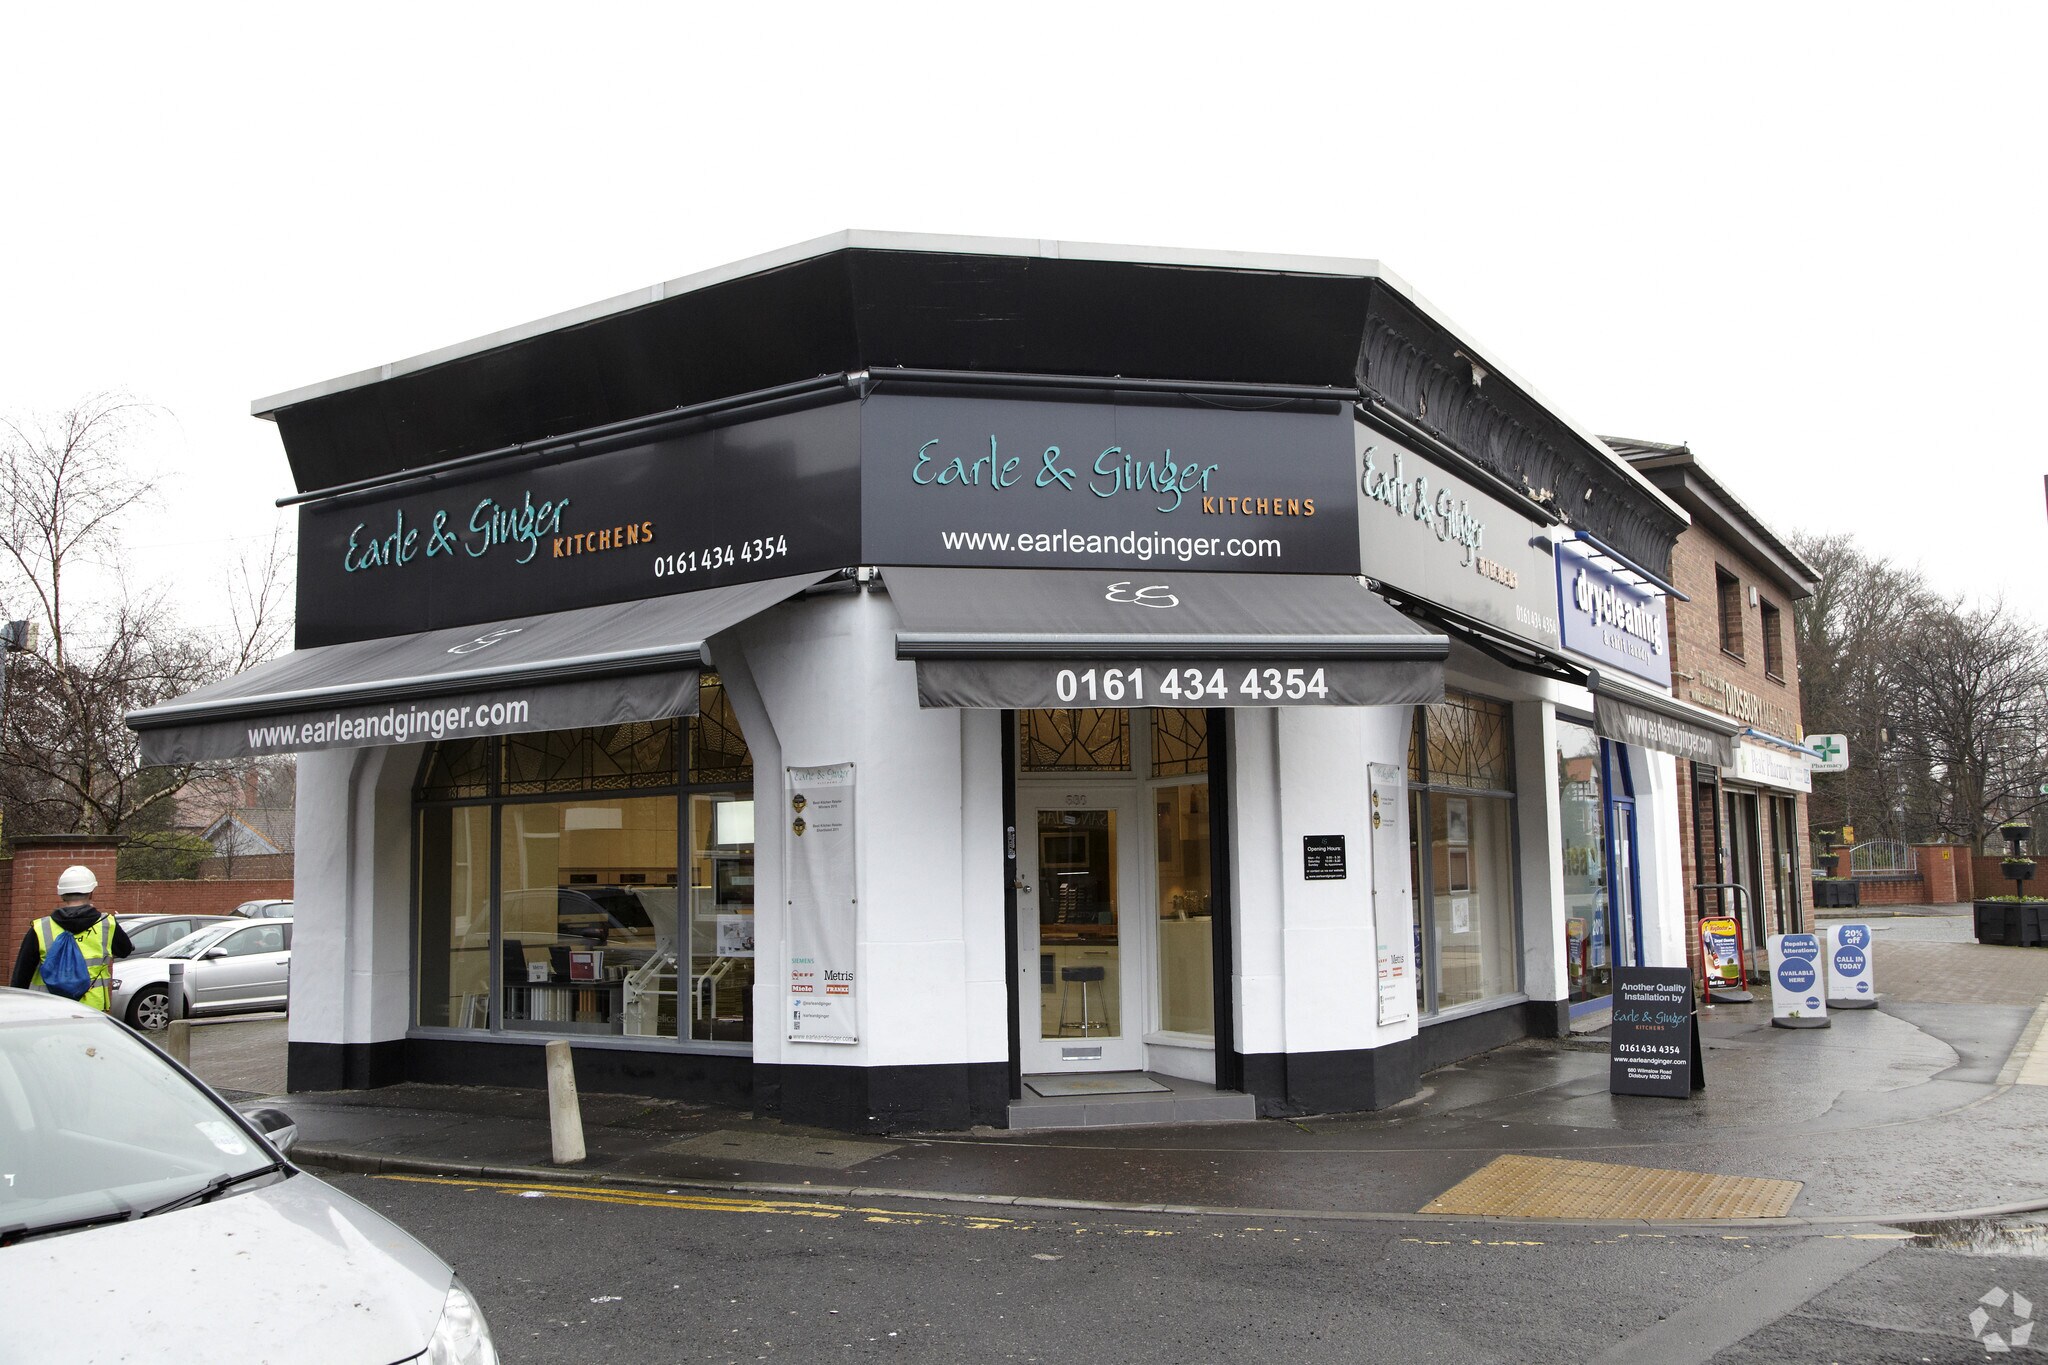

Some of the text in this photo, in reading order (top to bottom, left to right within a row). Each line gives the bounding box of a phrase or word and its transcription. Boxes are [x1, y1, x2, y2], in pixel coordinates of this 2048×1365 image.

[913, 435, 1217, 513] Earle & Ginger
[1202, 496, 1315, 517] KITCHENS
[1363, 446, 1485, 567] Earle & Ginger
[344, 490, 570, 572] Earle & Ginger
[553, 521, 653, 558] KITCHENS
[942, 529, 1281, 561] www.earleandginger.com
[655, 534, 788, 578] 0161 434 4354
[1516, 605, 1557, 636] 0161 434 4354
[1575, 568, 1663, 656] drycleaning
[1056, 667, 1329, 701] 0161 434 4354
[1725, 680, 1762, 727] DIDSBURY
[248, 700, 529, 749] www.earleandginger.com
[1626, 714, 1713, 756] www.earleandginger.com
[824, 970, 854, 981] Metris
[1621, 983, 1686, 993] Another Quality
[1624, 993, 1683, 1003] Installation by
[1613, 1009, 1688, 1028] Earle & Ginger
[1614, 1056, 1687, 1065] www.earleandginger.com
[1620, 1044, 1680, 1054] 0161 434 4354
